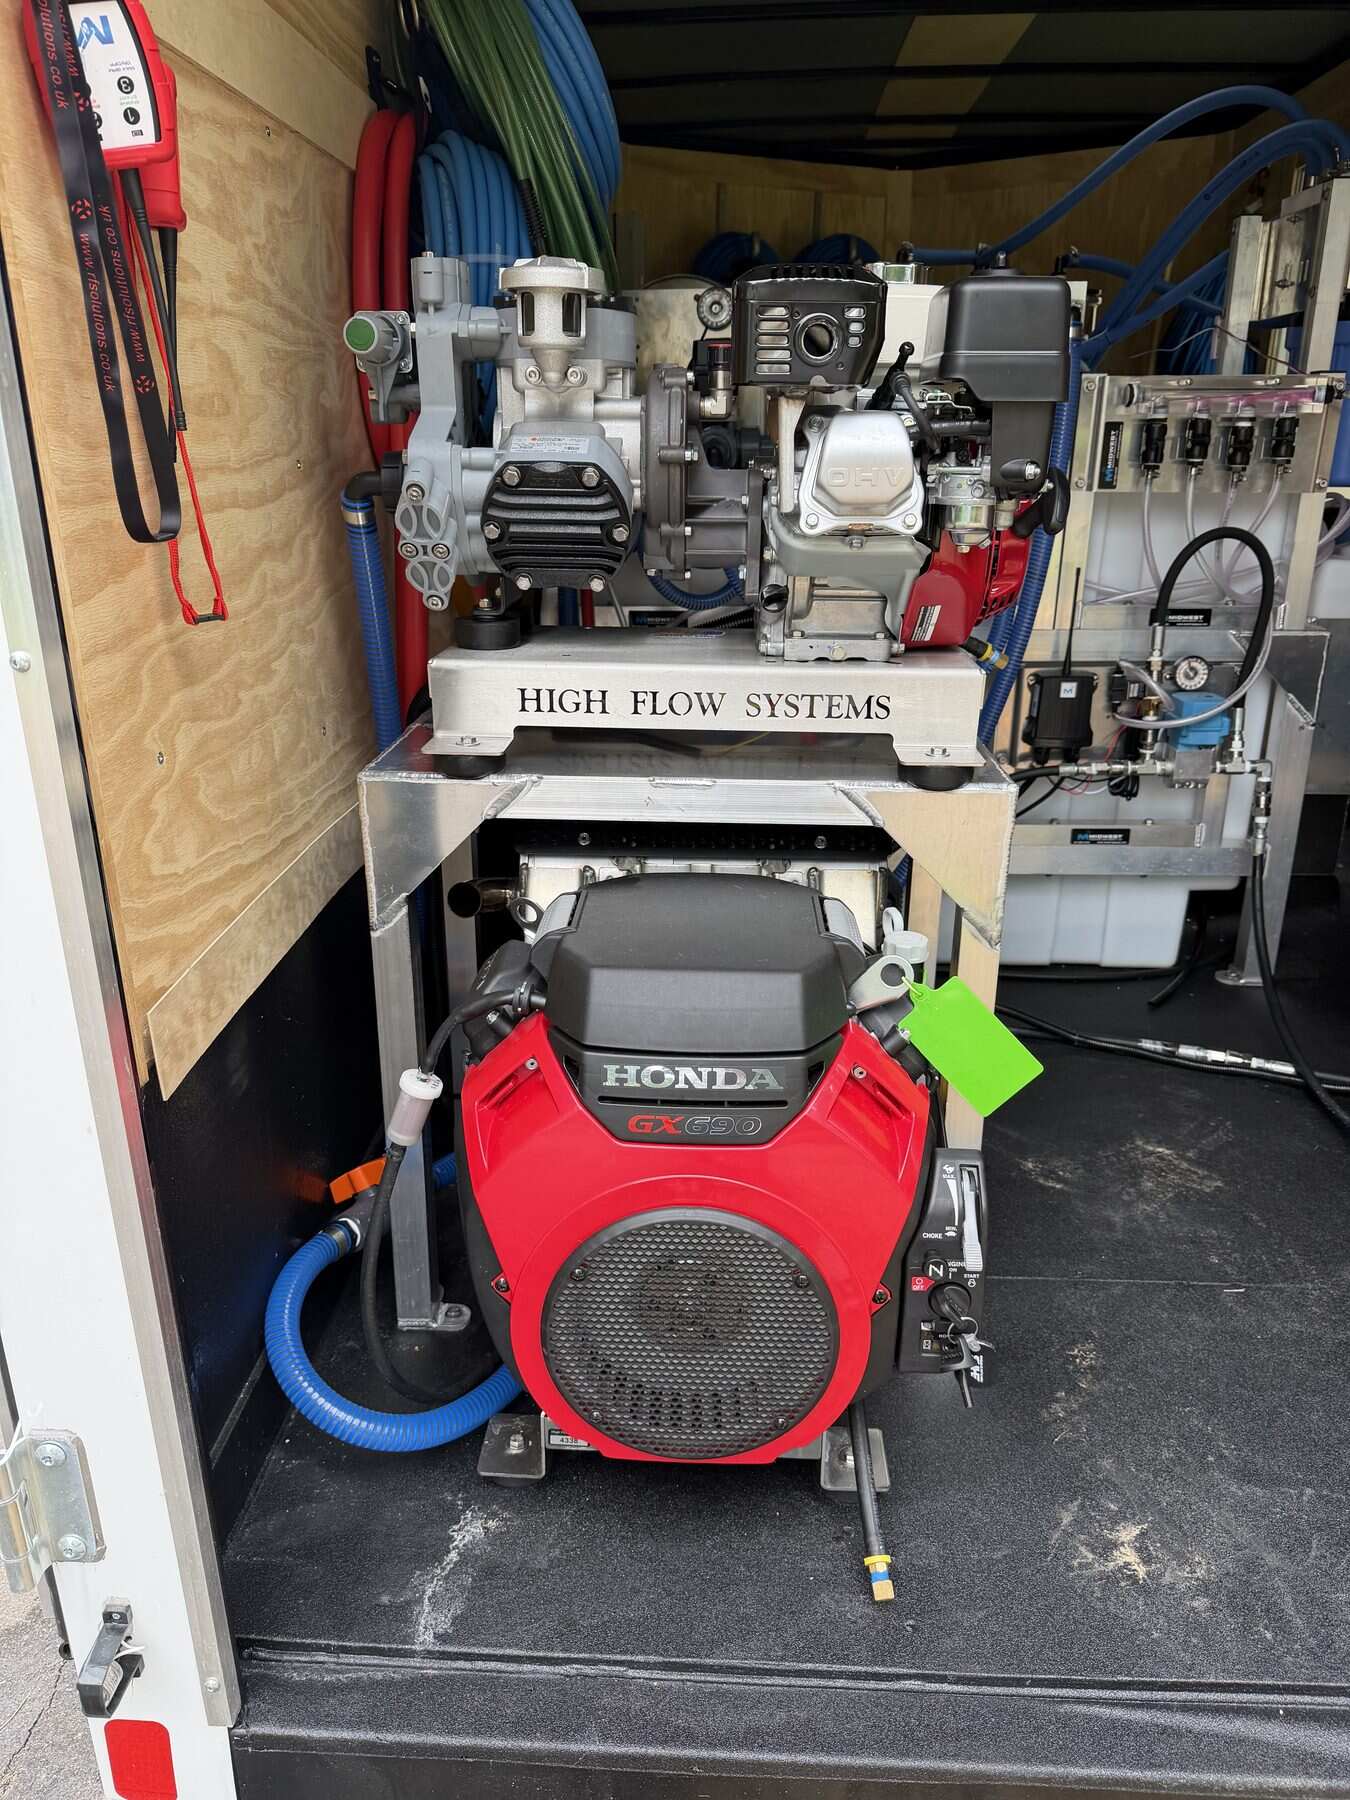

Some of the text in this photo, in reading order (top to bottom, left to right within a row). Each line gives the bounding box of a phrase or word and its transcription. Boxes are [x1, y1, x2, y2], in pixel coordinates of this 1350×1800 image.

[98, 205, 145, 363] www.rfsolutions.co.uk
[79, 232, 116, 392] www.rfsolutions.co.uk
[827, 464, 905, 488] OHV
[516, 687, 892, 720] HIGH FLOW SYSTEMS
[602, 1064, 784, 1090] HONDA
[627, 1113, 762, 1136] GX690
